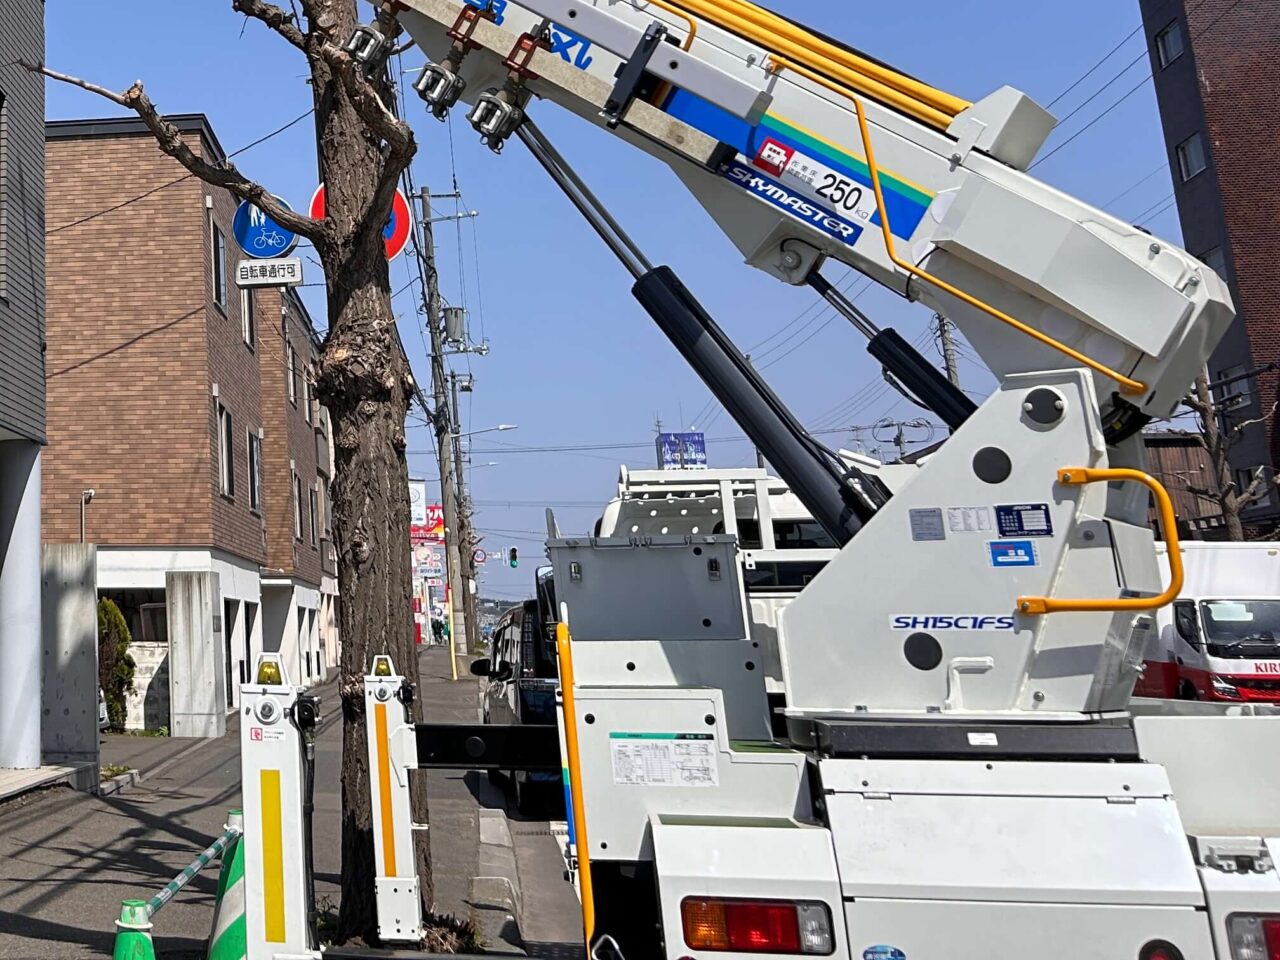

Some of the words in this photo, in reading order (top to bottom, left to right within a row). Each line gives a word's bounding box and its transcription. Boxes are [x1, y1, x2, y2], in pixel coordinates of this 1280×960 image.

[729, 167, 854, 238] SKYMASTER
[240, 264, 296, 279] 自転車通行可
[893, 616, 1014, 629] SH15C1FS
